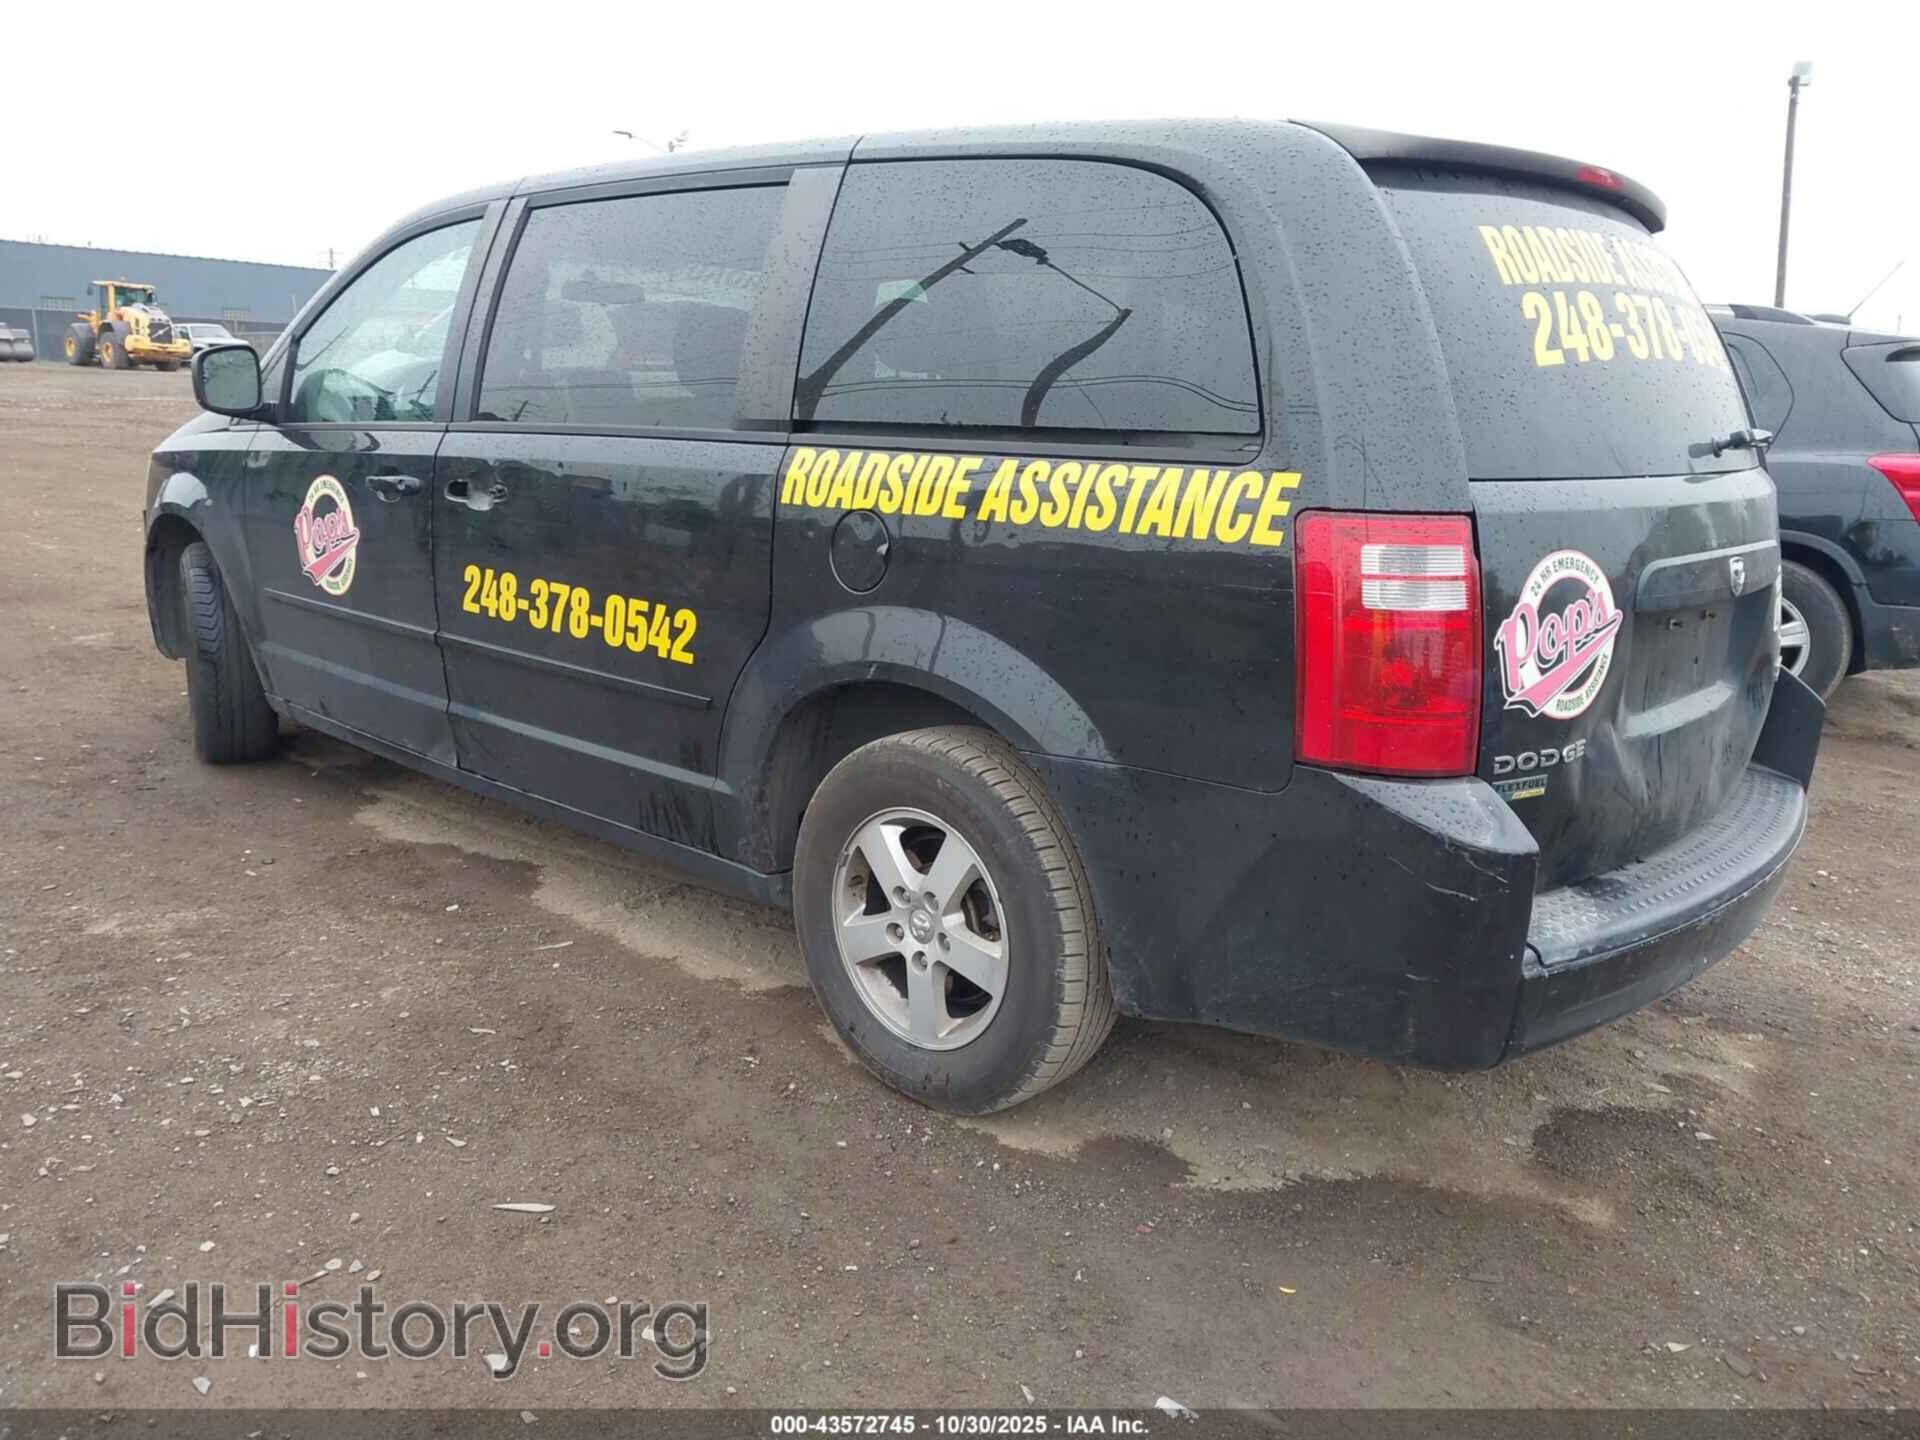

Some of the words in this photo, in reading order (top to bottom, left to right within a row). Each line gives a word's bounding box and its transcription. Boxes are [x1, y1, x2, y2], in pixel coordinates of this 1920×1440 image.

[1478, 225, 1627, 285] ROADSIDE
[780, 447, 982, 519] ROADSIDE
[977, 459, 1301, 546] ASSISTANCE
[463, 564, 698, 665] 248-378-0542
[1530, 580, 1543, 597] 24
[1540, 564, 1554, 583] HR
[1551, 556, 1600, 585] EMERGENCY
[1495, 590, 1610, 698] Pop's
[1493, 738, 1587, 775] DODGE
